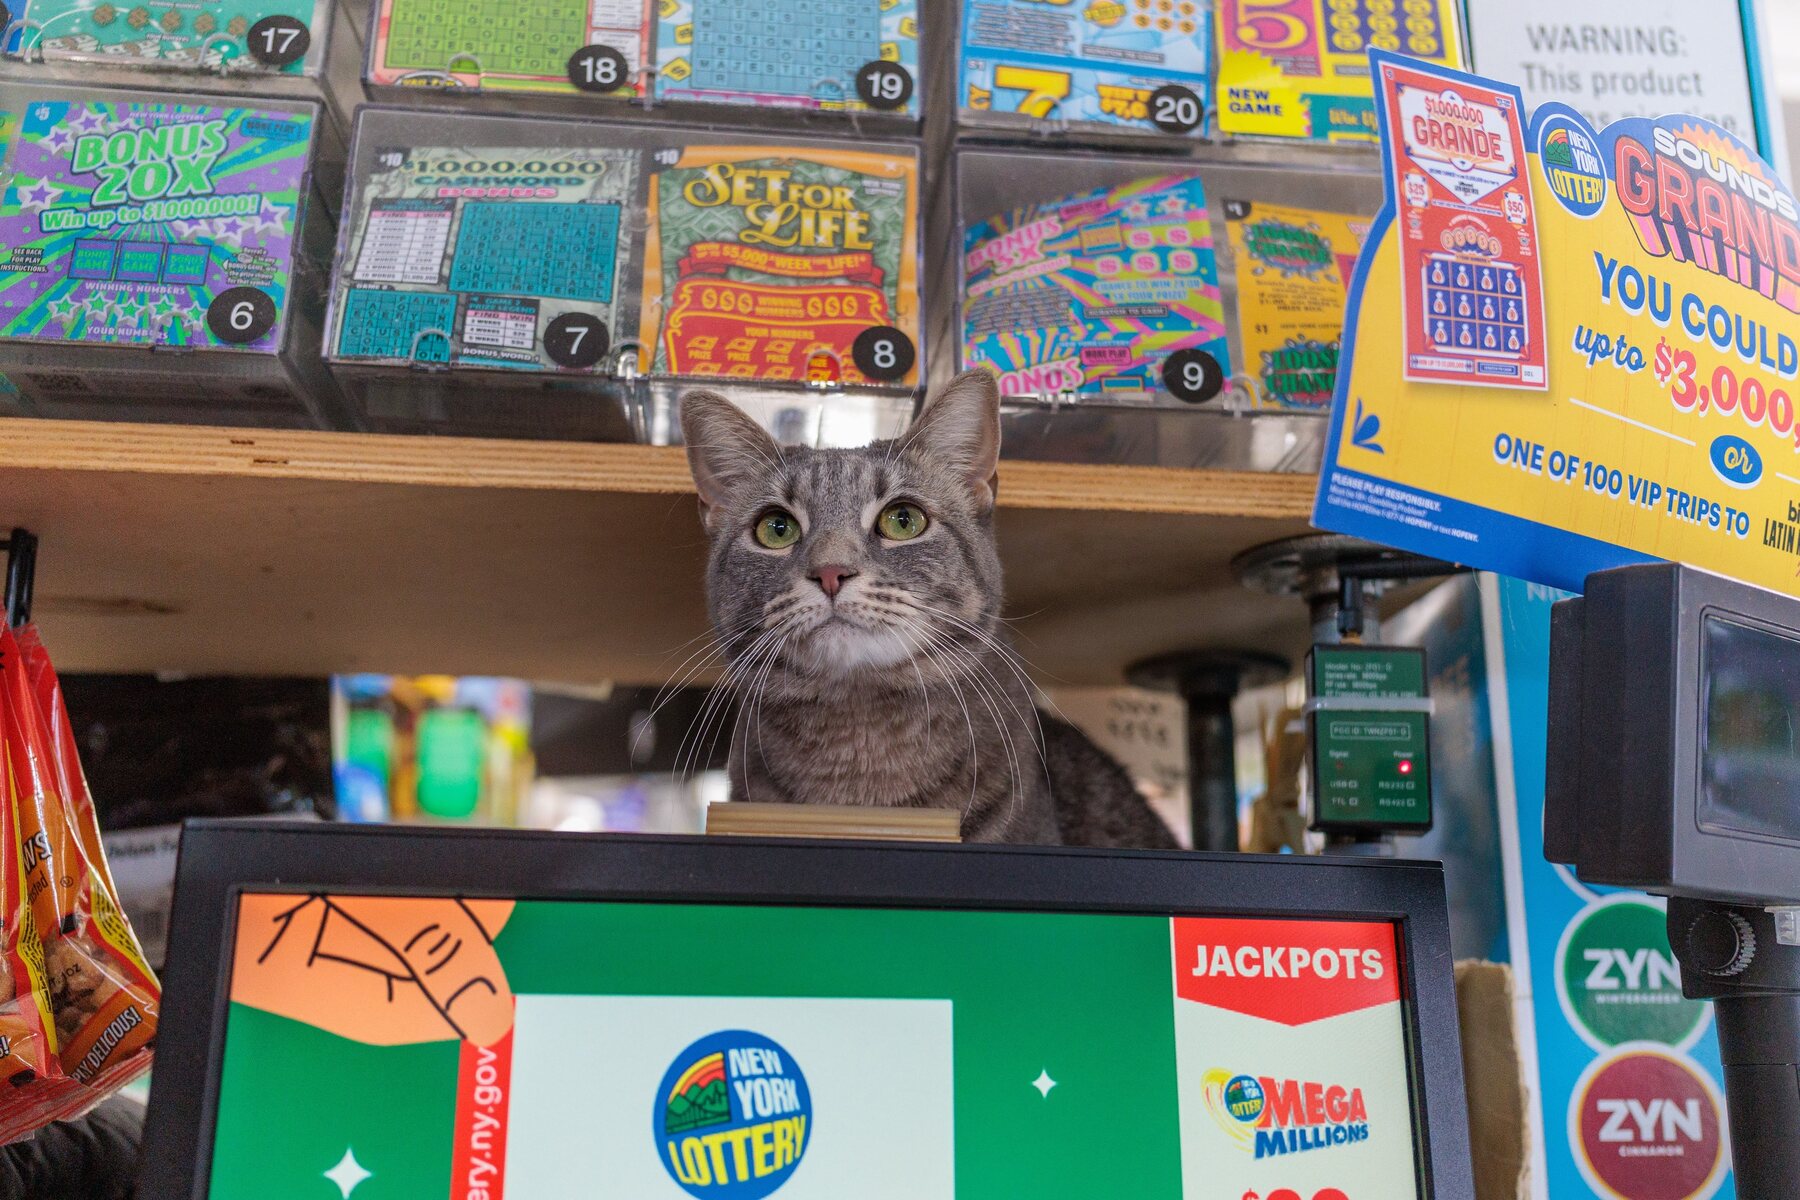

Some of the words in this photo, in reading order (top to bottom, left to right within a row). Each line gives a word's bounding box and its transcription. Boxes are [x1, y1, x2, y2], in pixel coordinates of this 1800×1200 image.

[1236, 0, 1307, 49] 5
[261, 27, 301, 54] 17
[1526, 24, 1688, 58] WARNING:
[579, 57, 618, 84] 18
[1520, 62, 1581, 93] This
[1591, 66, 1704, 97] product
[866, 72, 904, 99] 19
[1229, 88, 1270, 101] NEW
[1155, 96, 1199, 125] 20
[1229, 102, 1284, 116] GAME
[73, 120, 228, 173] BONUS
[1412, 115, 1504, 162] GRANDE
[1567, 129, 1591, 151] NEW
[380, 152, 403, 167] $10
[655, 150, 679, 165] $10
[1571, 148, 1601, 177] YORK
[92, 156, 216, 206] 20X
[414, 175, 587, 186] CASHWORD
[684, 162, 791, 207] SET
[789, 183, 857, 210] FOR
[1546, 166, 1604, 205] LOTTERY
[1652, 126, 1799, 223] SOUNDS
[43, 210, 88, 230] Win
[89, 210, 117, 228] up
[119, 207, 140, 221] to
[1506, 199, 1524, 213] $50
[739, 201, 874, 250] LIFE
[968, 215, 1061, 270] BONUS
[773, 256, 813, 271] WEEK
[85, 282, 133, 293] WINNING
[136, 284, 186, 295] NUMBERS
[230, 301, 255, 330] 6
[510, 314, 533, 322] WIN
[1593, 250, 1673, 330] YOU
[1681, 292, 1799, 378] COULD
[86, 326, 116, 336] YOUR
[565, 326, 589, 355] 7
[463, 347, 498, 356] BONUS
[499, 351, 531, 361] WORD
[873, 340, 896, 369] 8
[1573, 324, 1613, 368] up
[1612, 334, 1647, 373] to
[1182, 362, 1205, 391] 9
[1724, 446, 1754, 475] or
[1331, 472, 1365, 491] PLEASE
[1364, 480, 1385, 496] PLAY
[1494, 432, 1544, 472] ONE
[1549, 450, 1579, 486] OF
[1583, 461, 1623, 496] 100
[1628, 474, 1662, 511] VIP
[1665, 486, 1720, 527] TRIPS
[1725, 506, 1751, 540] TO
[1763, 517, 1796, 554] LATIN
[1192, 945, 1384, 981] JACKPOTS
[88, 1006, 143, 1069] DELICIOUS!
[728, 1048, 784, 1077] NEW
[734, 1078, 801, 1121] YORK
[1256, 1076, 1368, 1129] MEGA
[1597, 1099, 1703, 1142] ZYN
[668, 1115, 806, 1186] LOTTERY
[1254, 1124, 1369, 1160] MILLIONS
